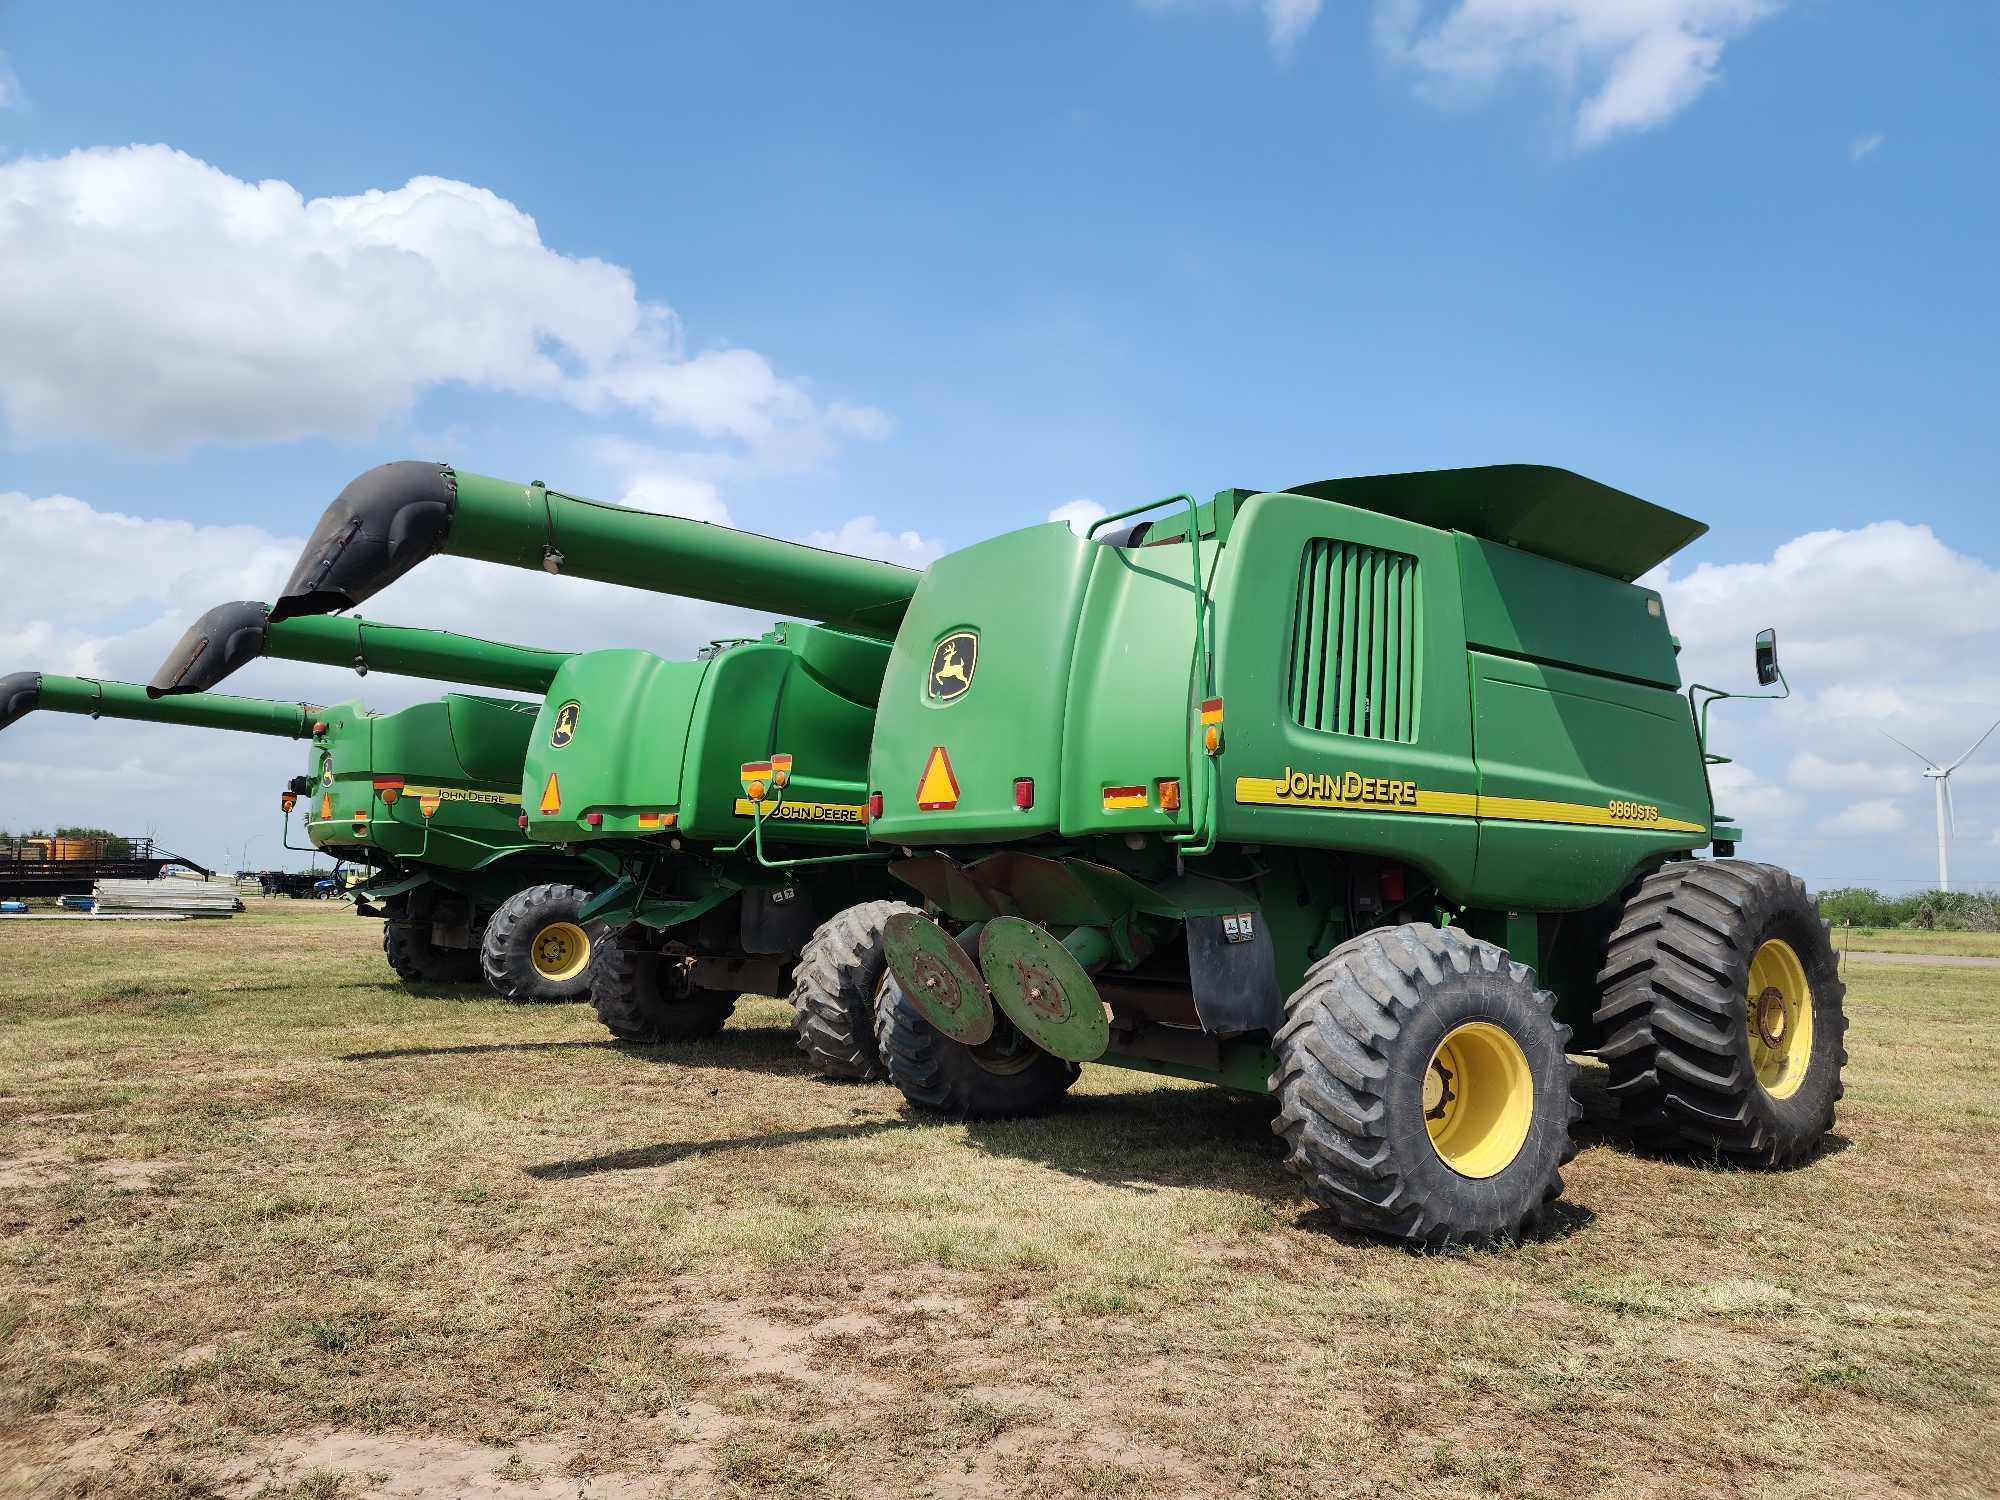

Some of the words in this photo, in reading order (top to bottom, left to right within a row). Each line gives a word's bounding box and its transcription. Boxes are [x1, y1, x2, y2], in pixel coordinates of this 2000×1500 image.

[1276, 766, 1342, 800] JOHN
[1343, 771, 1417, 804] DEERE
[468, 791, 506, 804] DEERE
[814, 805, 858, 821] DEERE
[1609, 799, 1658, 821] 9860STS
